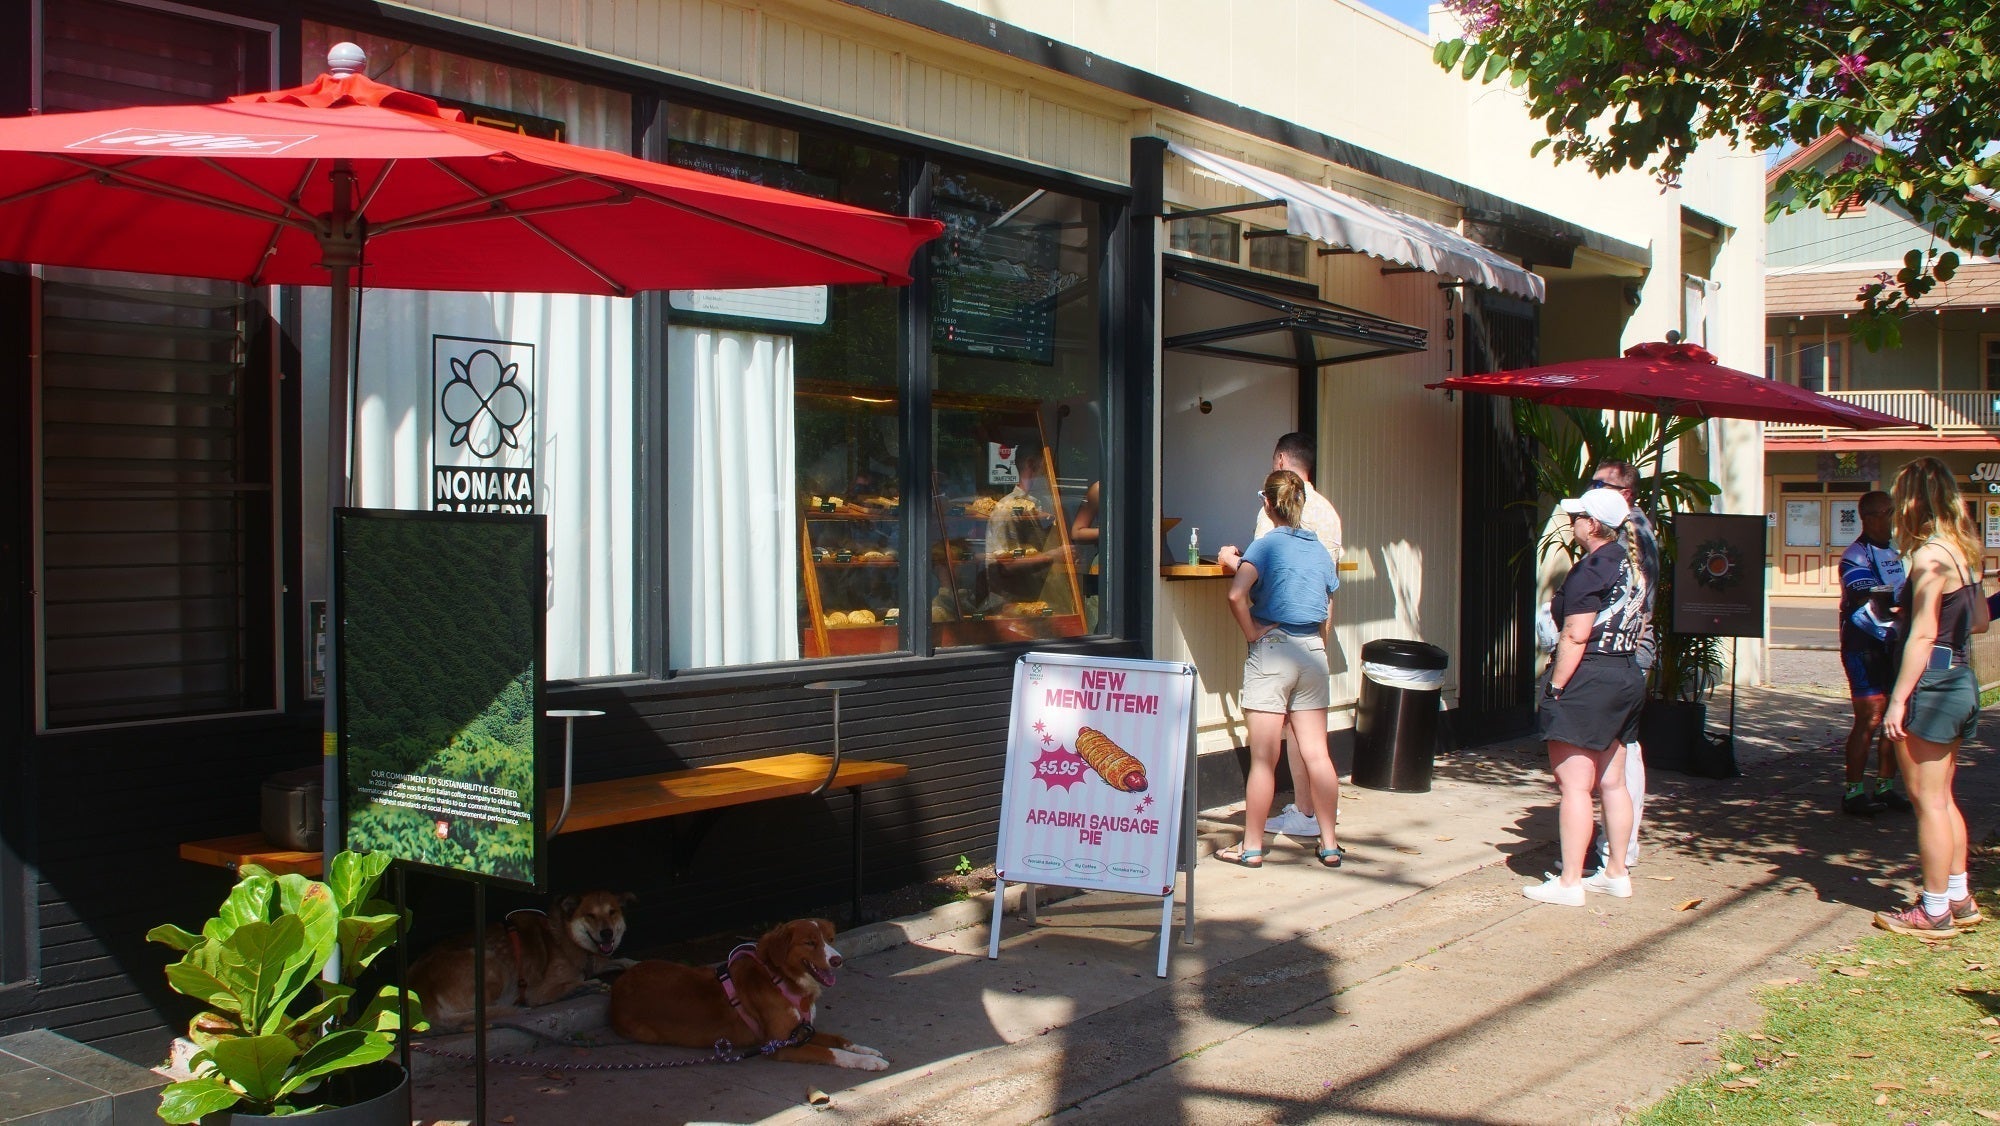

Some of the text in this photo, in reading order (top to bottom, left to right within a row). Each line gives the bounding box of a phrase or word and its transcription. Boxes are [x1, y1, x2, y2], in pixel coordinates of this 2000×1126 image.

[436, 470, 532, 501] NONAKA
[1081, 670, 1127, 691] NEW
[1045, 688, 1159, 715] MENU ITEM!
[1038, 760, 1080, 776] $5.95
[371, 769, 519, 799] OUR COMMITMENT TO SUSTAINABILITY IS CERTIFIED.
[375, 780, 388, 788] 2021
[407, 784, 418, 792] was
[418, 784, 426, 793] the
[427, 785, 436, 794] first
[436, 788, 451, 796] Italian
[451, 790, 467, 799] coffee
[467, 793, 491, 804] company
[498, 797, 513, 807] obtain
[513, 800, 521, 809] the
[379, 798, 397, 806] highest
[397, 800, 421, 809] standards
[428, 804, 442, 812] social
[451, 809, 487, 820] environmental
[393, 790, 406, 800] Corp
[436, 797, 452, 805] thanks
[468, 803, 501, 813] commitment
[507, 808, 531, 821] respecting
[1026, 808, 1159, 835] ARABIKI SAUSAGE
[1079, 829, 1102, 846] PIE
